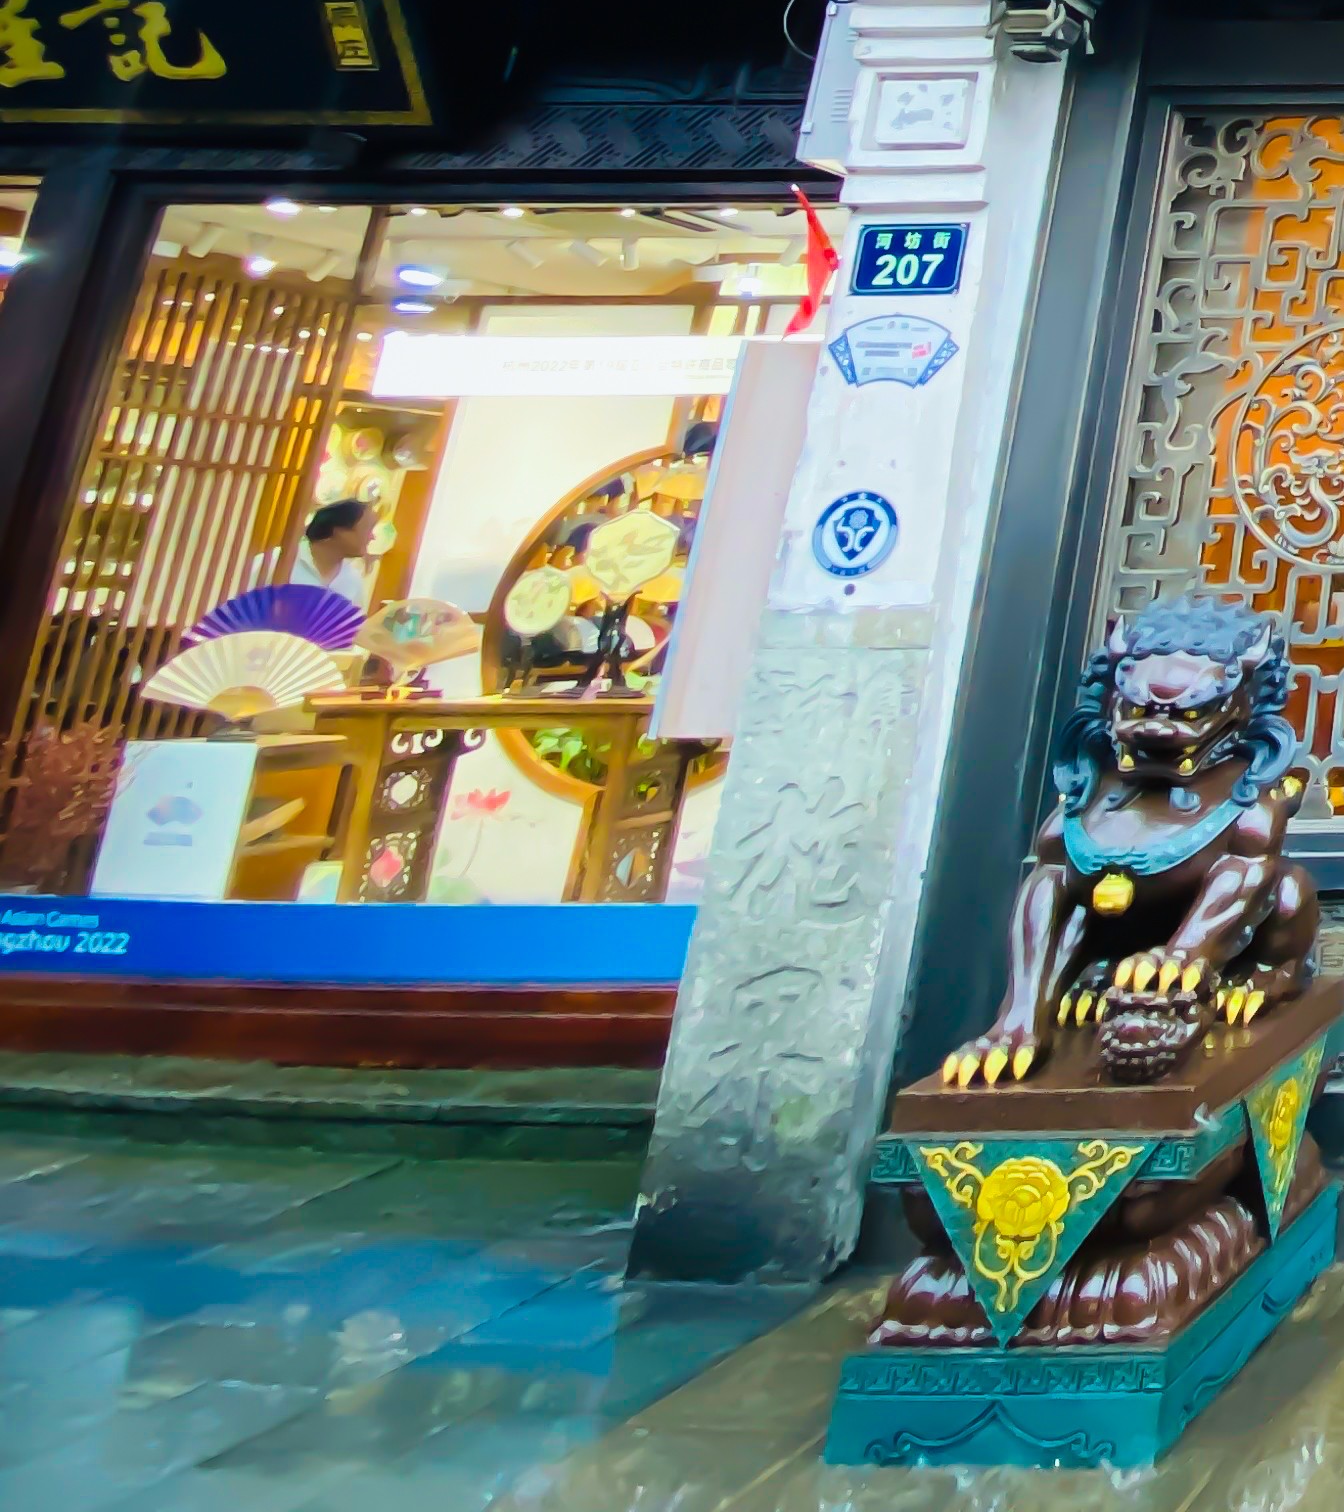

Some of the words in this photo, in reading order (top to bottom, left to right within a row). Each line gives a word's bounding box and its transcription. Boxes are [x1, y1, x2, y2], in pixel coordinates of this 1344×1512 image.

[875, 231, 952, 250] 河坊街
[871, 253, 945, 286] 207
[73, 931, 130, 955] 2022
